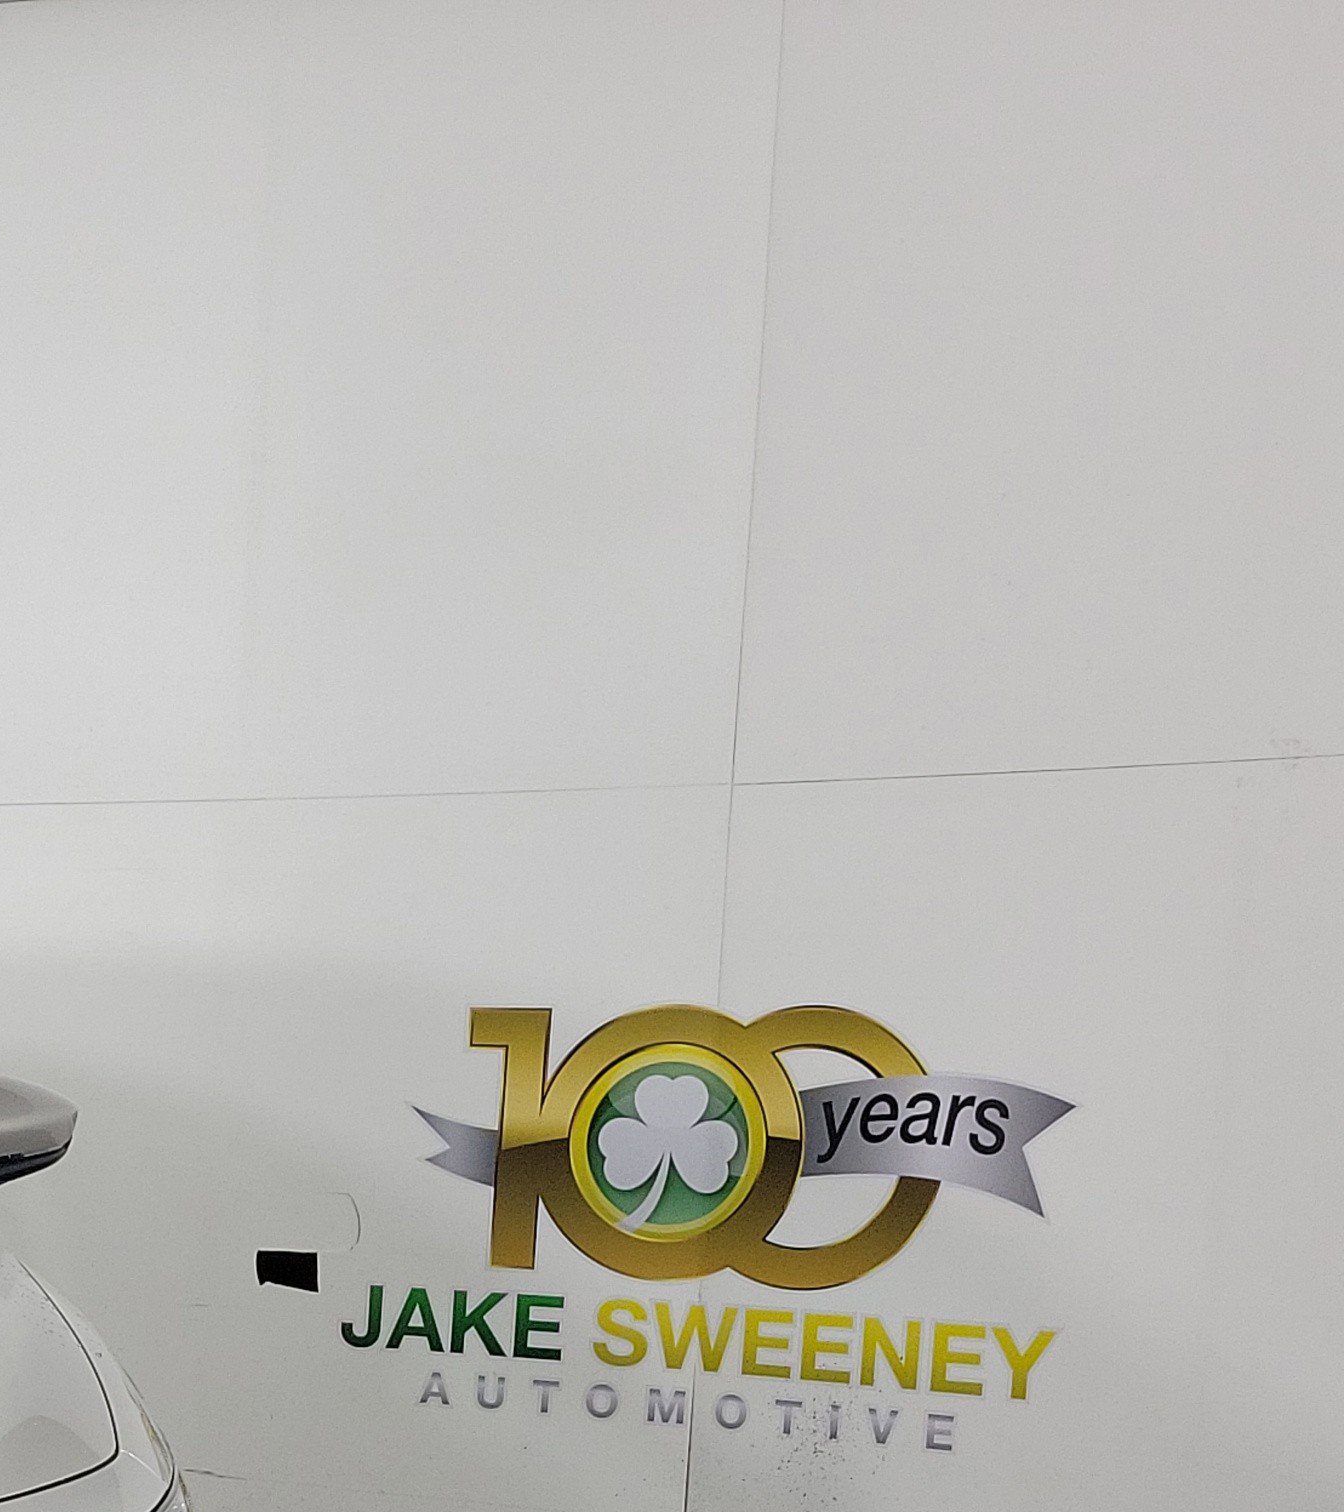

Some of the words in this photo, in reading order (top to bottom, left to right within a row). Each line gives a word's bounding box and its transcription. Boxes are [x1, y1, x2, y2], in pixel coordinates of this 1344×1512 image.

[816, 1090, 1010, 1164] years
[340, 1284, 566, 1362] JAKE
[592, 1297, 1058, 1401] SWEENEY
[420, 1371, 957, 1453] AUTOMOTIVE
